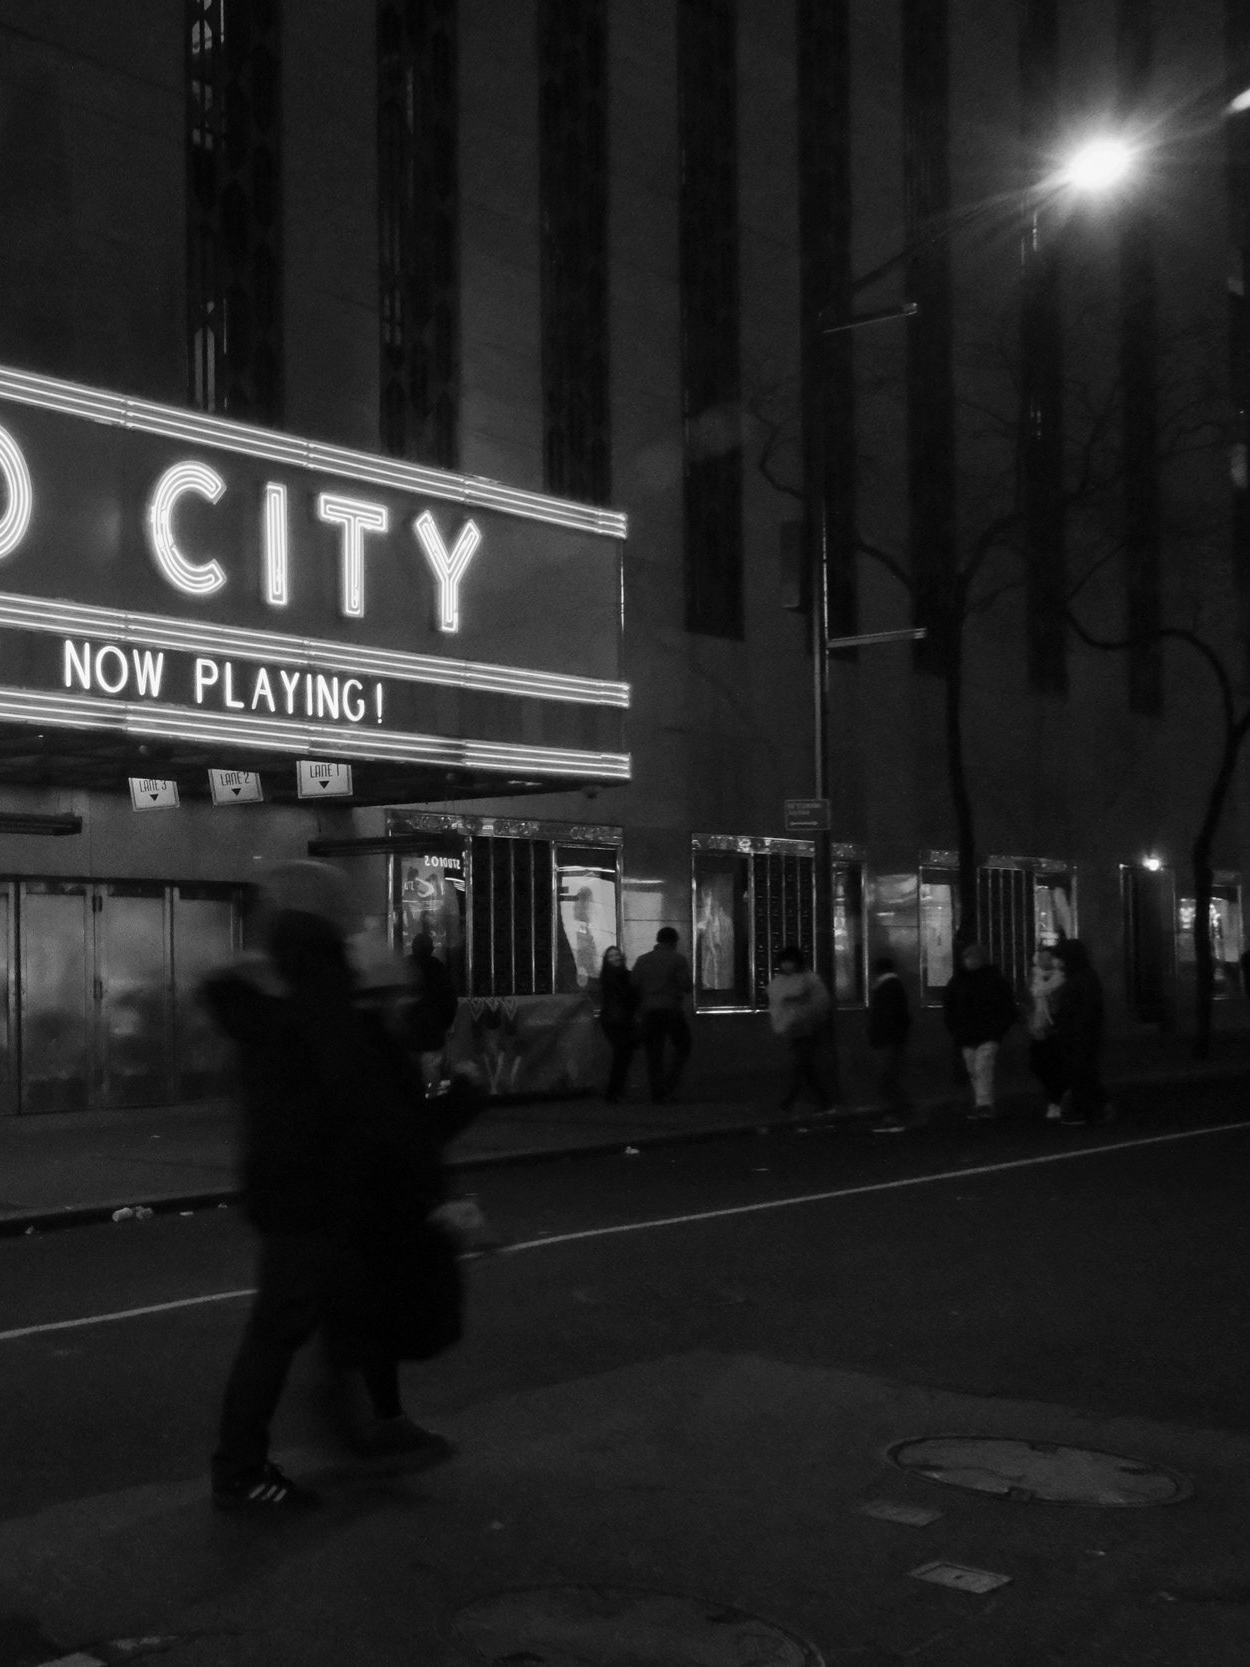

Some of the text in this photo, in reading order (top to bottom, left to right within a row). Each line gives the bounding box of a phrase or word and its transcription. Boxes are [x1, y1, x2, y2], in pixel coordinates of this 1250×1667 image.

[150, 460, 482, 633] CITY
[63, 639, 164, 697] NOW
[195, 657, 383, 724] PLAYING!
[310, 763, 333, 778] LANE
[139, 779, 159, 792] LANE
[220, 771, 250, 786] LANE 2
